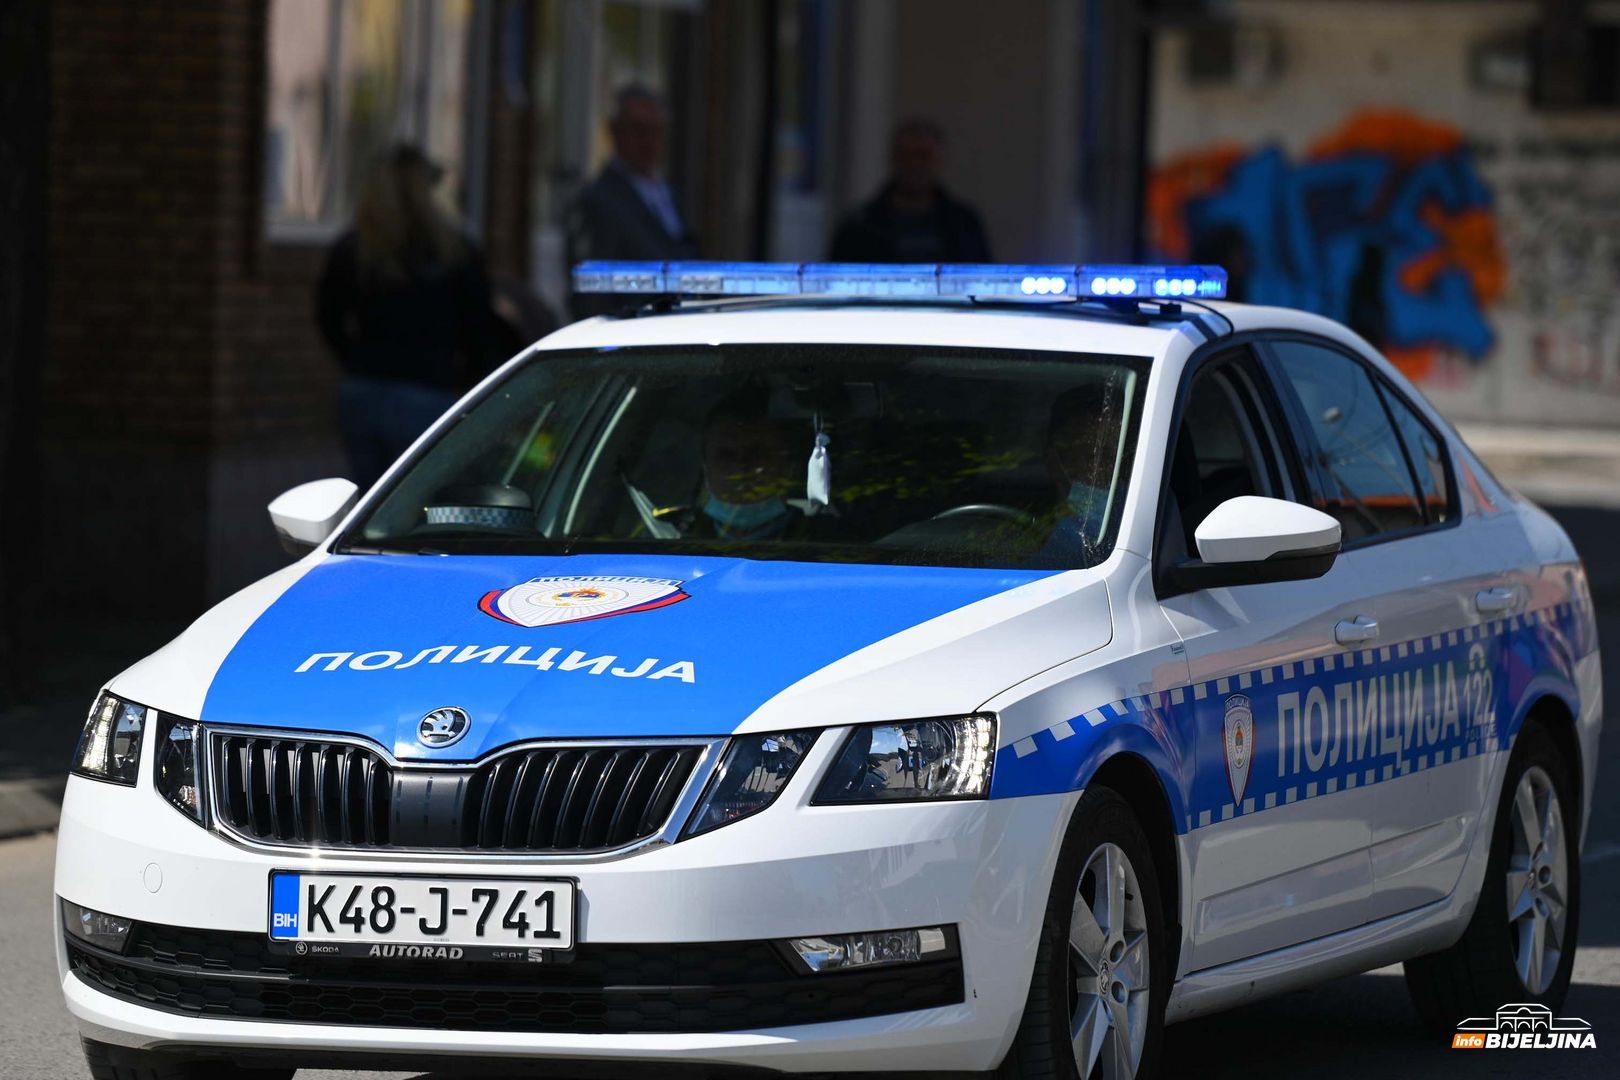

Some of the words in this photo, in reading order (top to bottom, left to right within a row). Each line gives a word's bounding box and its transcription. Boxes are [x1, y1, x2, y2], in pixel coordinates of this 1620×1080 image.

[294, 645, 695, 683] ПОЛИЦИЈА
[1277, 660, 1460, 777] ПОЛИЦИЈА
[1463, 668, 1496, 729] 122
[273, 912, 298, 928] BIH
[307, 884, 561, 939] K48-J-741
[369, 944, 464, 960] AUTORAD
